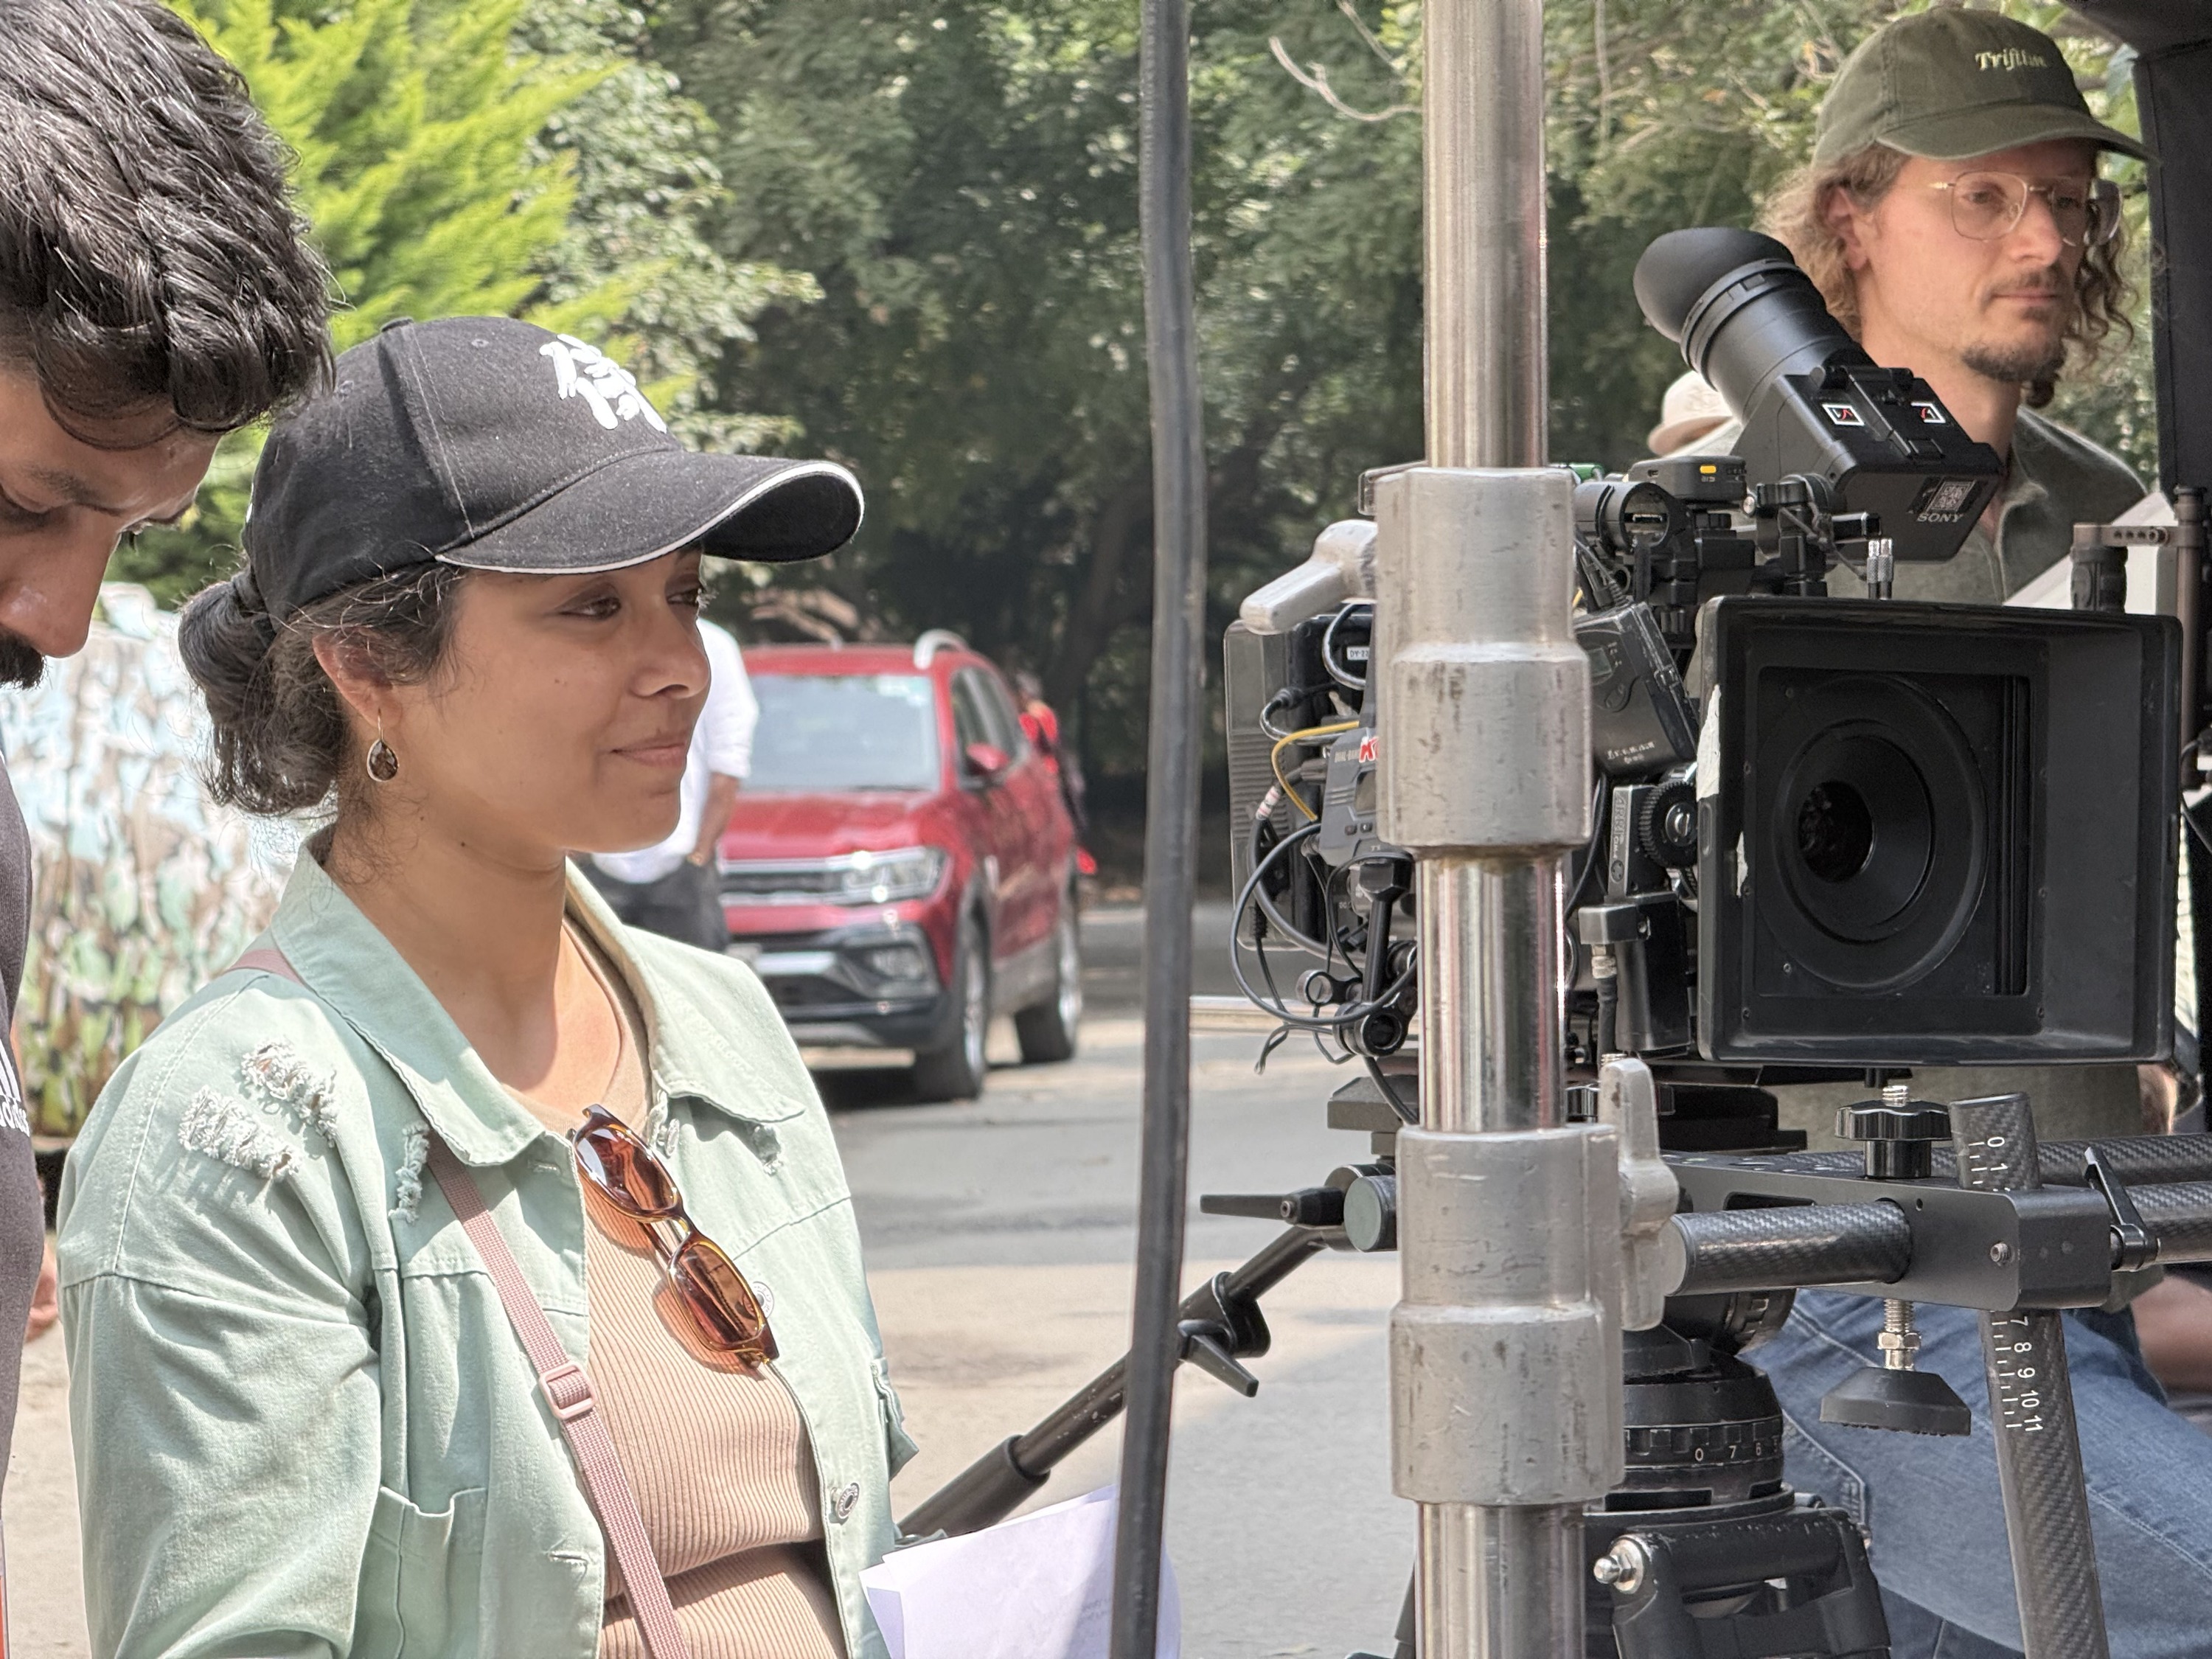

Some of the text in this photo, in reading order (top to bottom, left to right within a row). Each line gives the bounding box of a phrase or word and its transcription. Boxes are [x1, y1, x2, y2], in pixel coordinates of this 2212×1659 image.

[1916, 512, 1964, 523] SONY
[1987, 1136, 2005, 1147] 0
[1990, 1163, 2008, 1172] 1
[2010, 1316, 2043, 1431] 7 8 9 10 11
[1694, 1447, 1704, 1461] 0
[1728, 1445, 1737, 1459] 7
